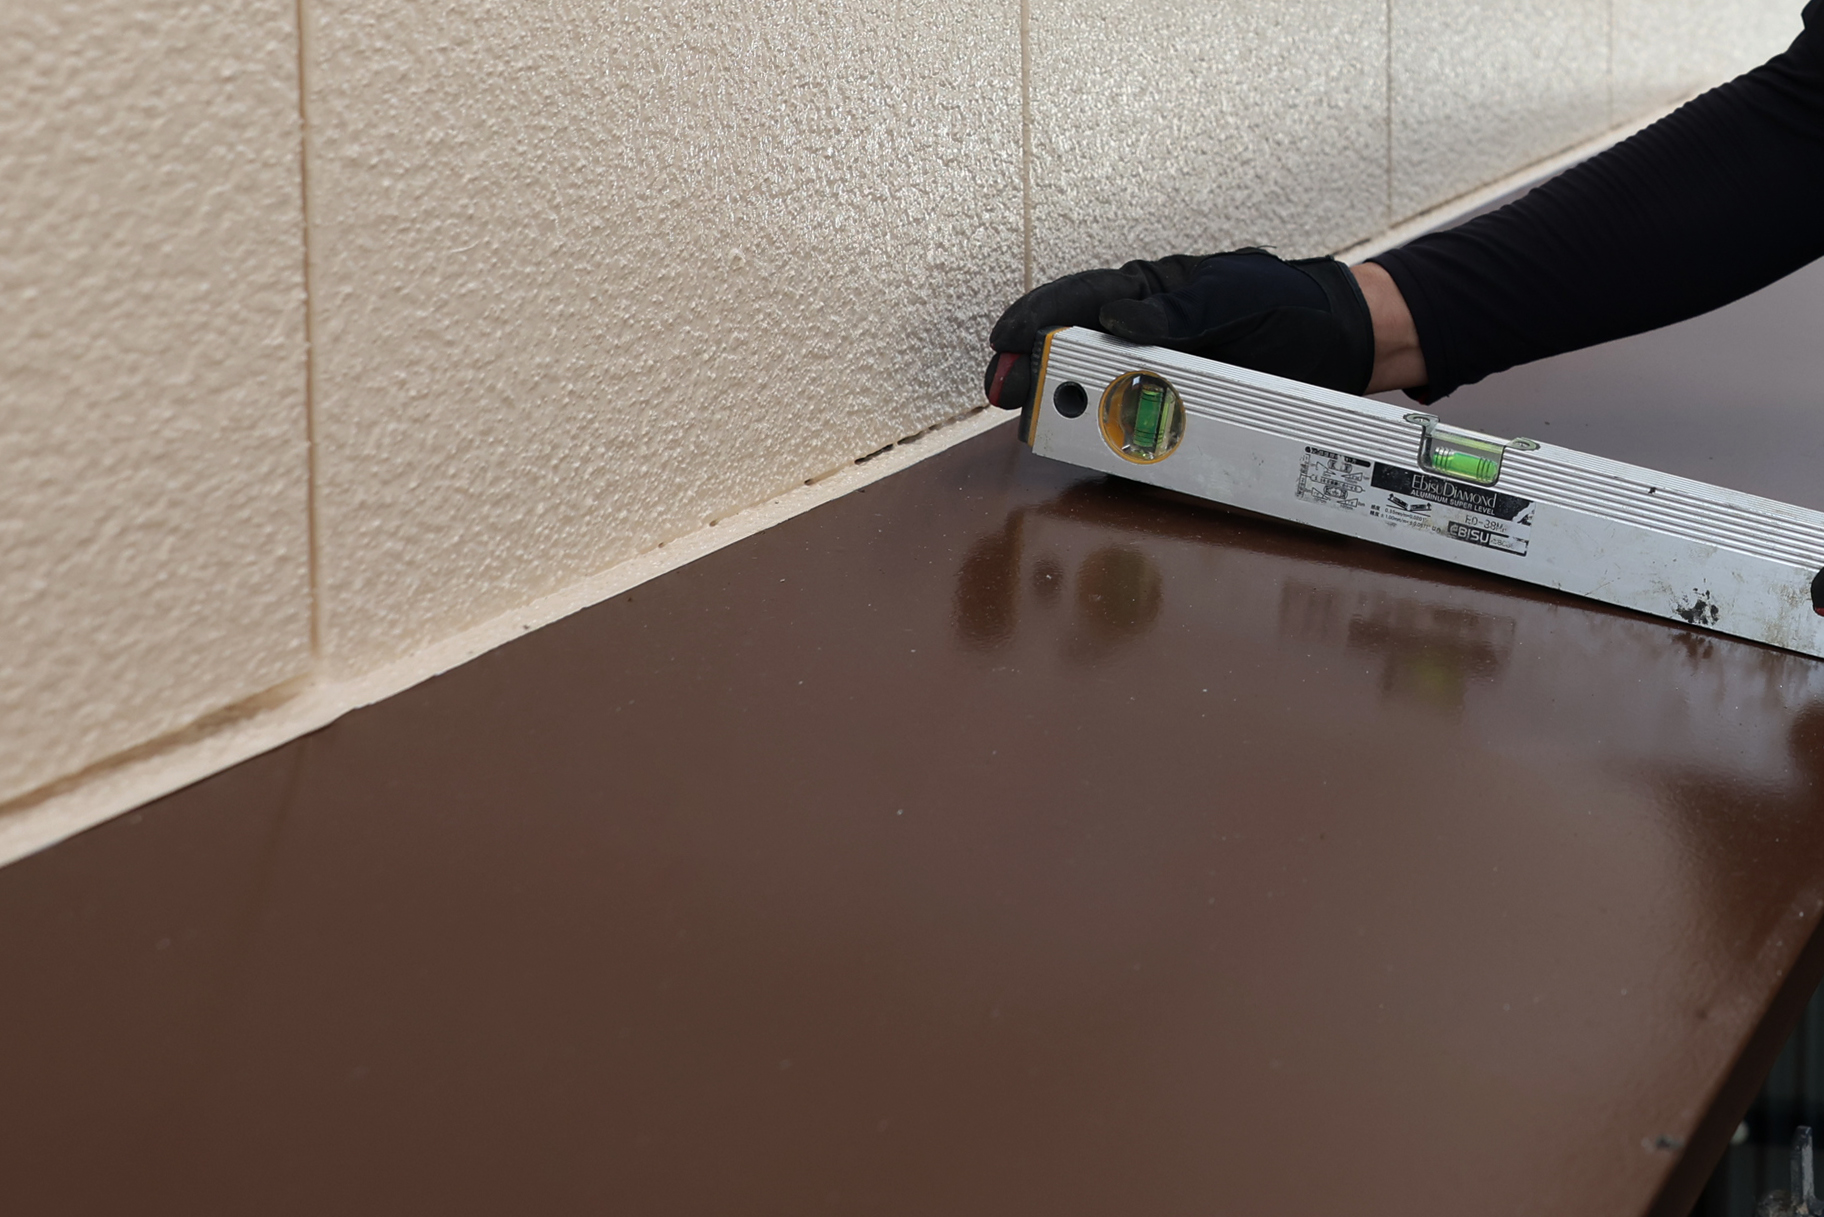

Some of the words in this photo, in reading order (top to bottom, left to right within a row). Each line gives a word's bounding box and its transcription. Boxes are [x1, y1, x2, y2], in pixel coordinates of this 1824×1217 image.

[1410, 489, 1448, 503] ALUMINUM
[1449, 498, 1473, 511] SUPER
[1473, 504, 1496, 516] LEVEL
